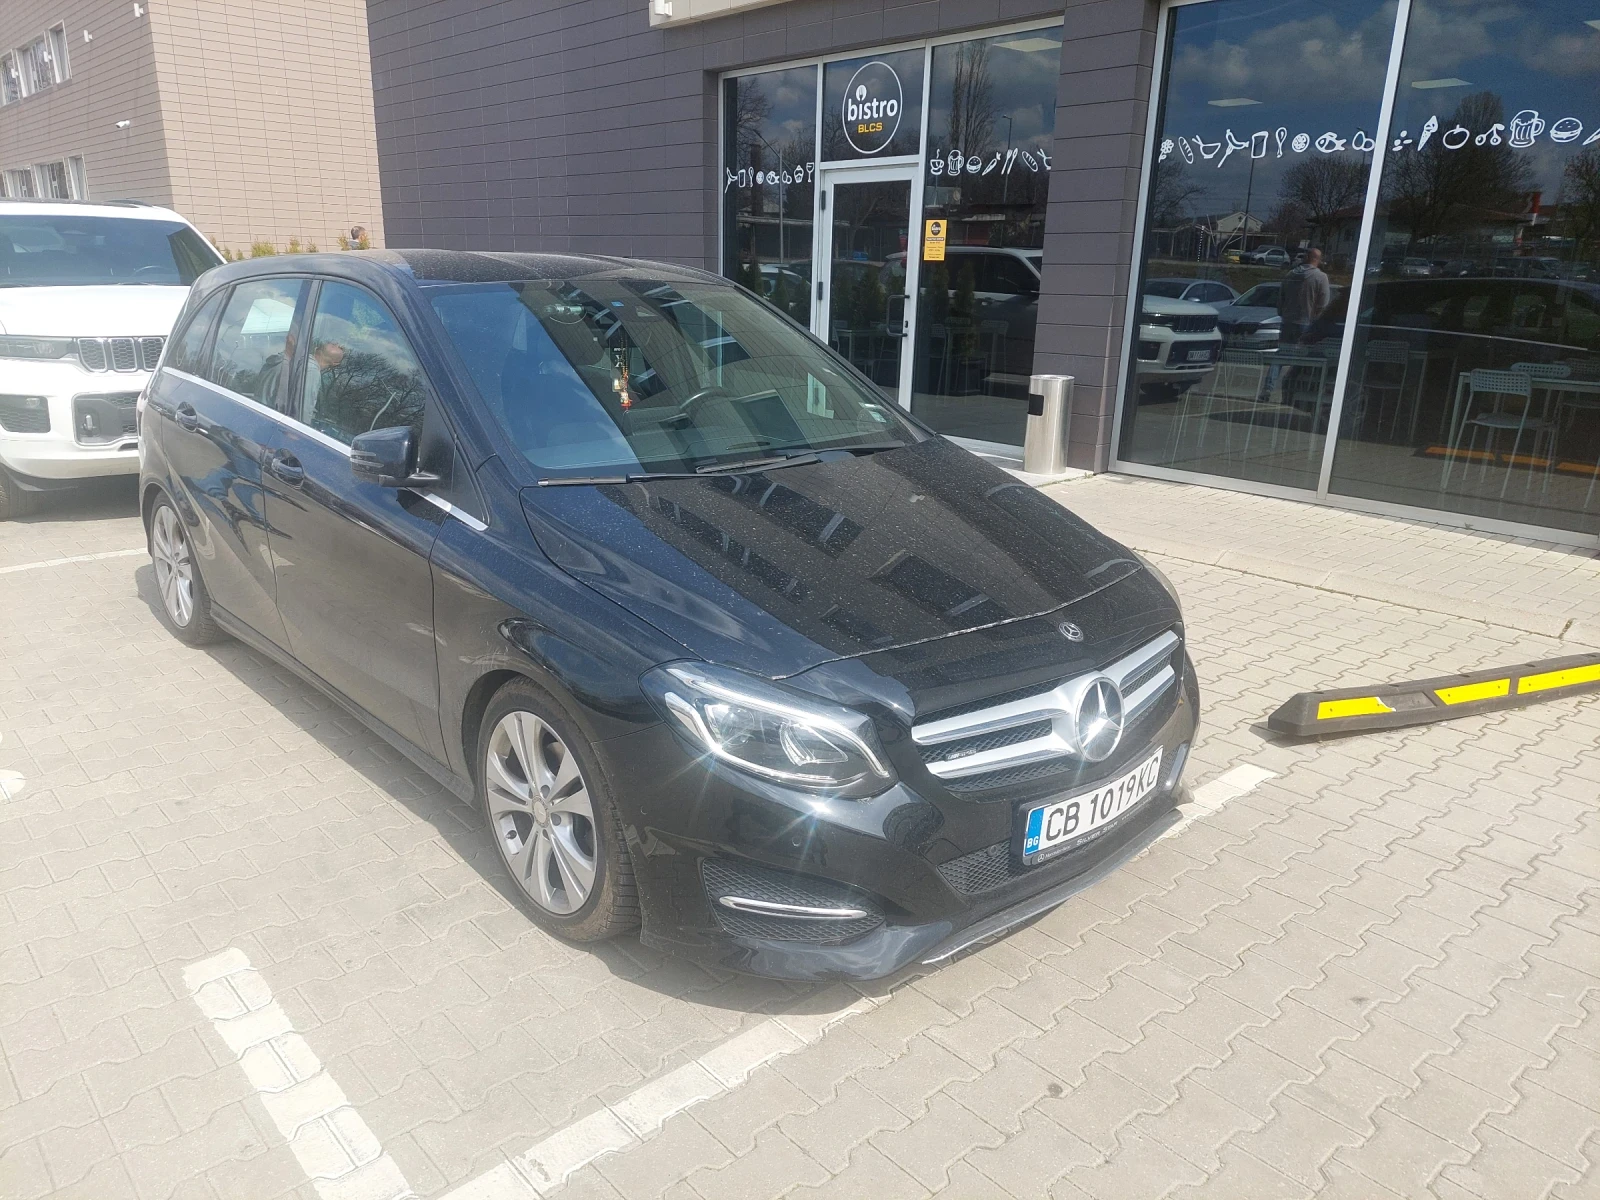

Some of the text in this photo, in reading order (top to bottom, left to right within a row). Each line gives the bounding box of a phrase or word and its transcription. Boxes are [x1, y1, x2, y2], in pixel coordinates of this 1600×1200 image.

[848, 86, 898, 121] bistro
[857, 122, 883, 133] BLCS
[1046, 801, 1080, 841] CB
[1026, 835, 1039, 849] BG
